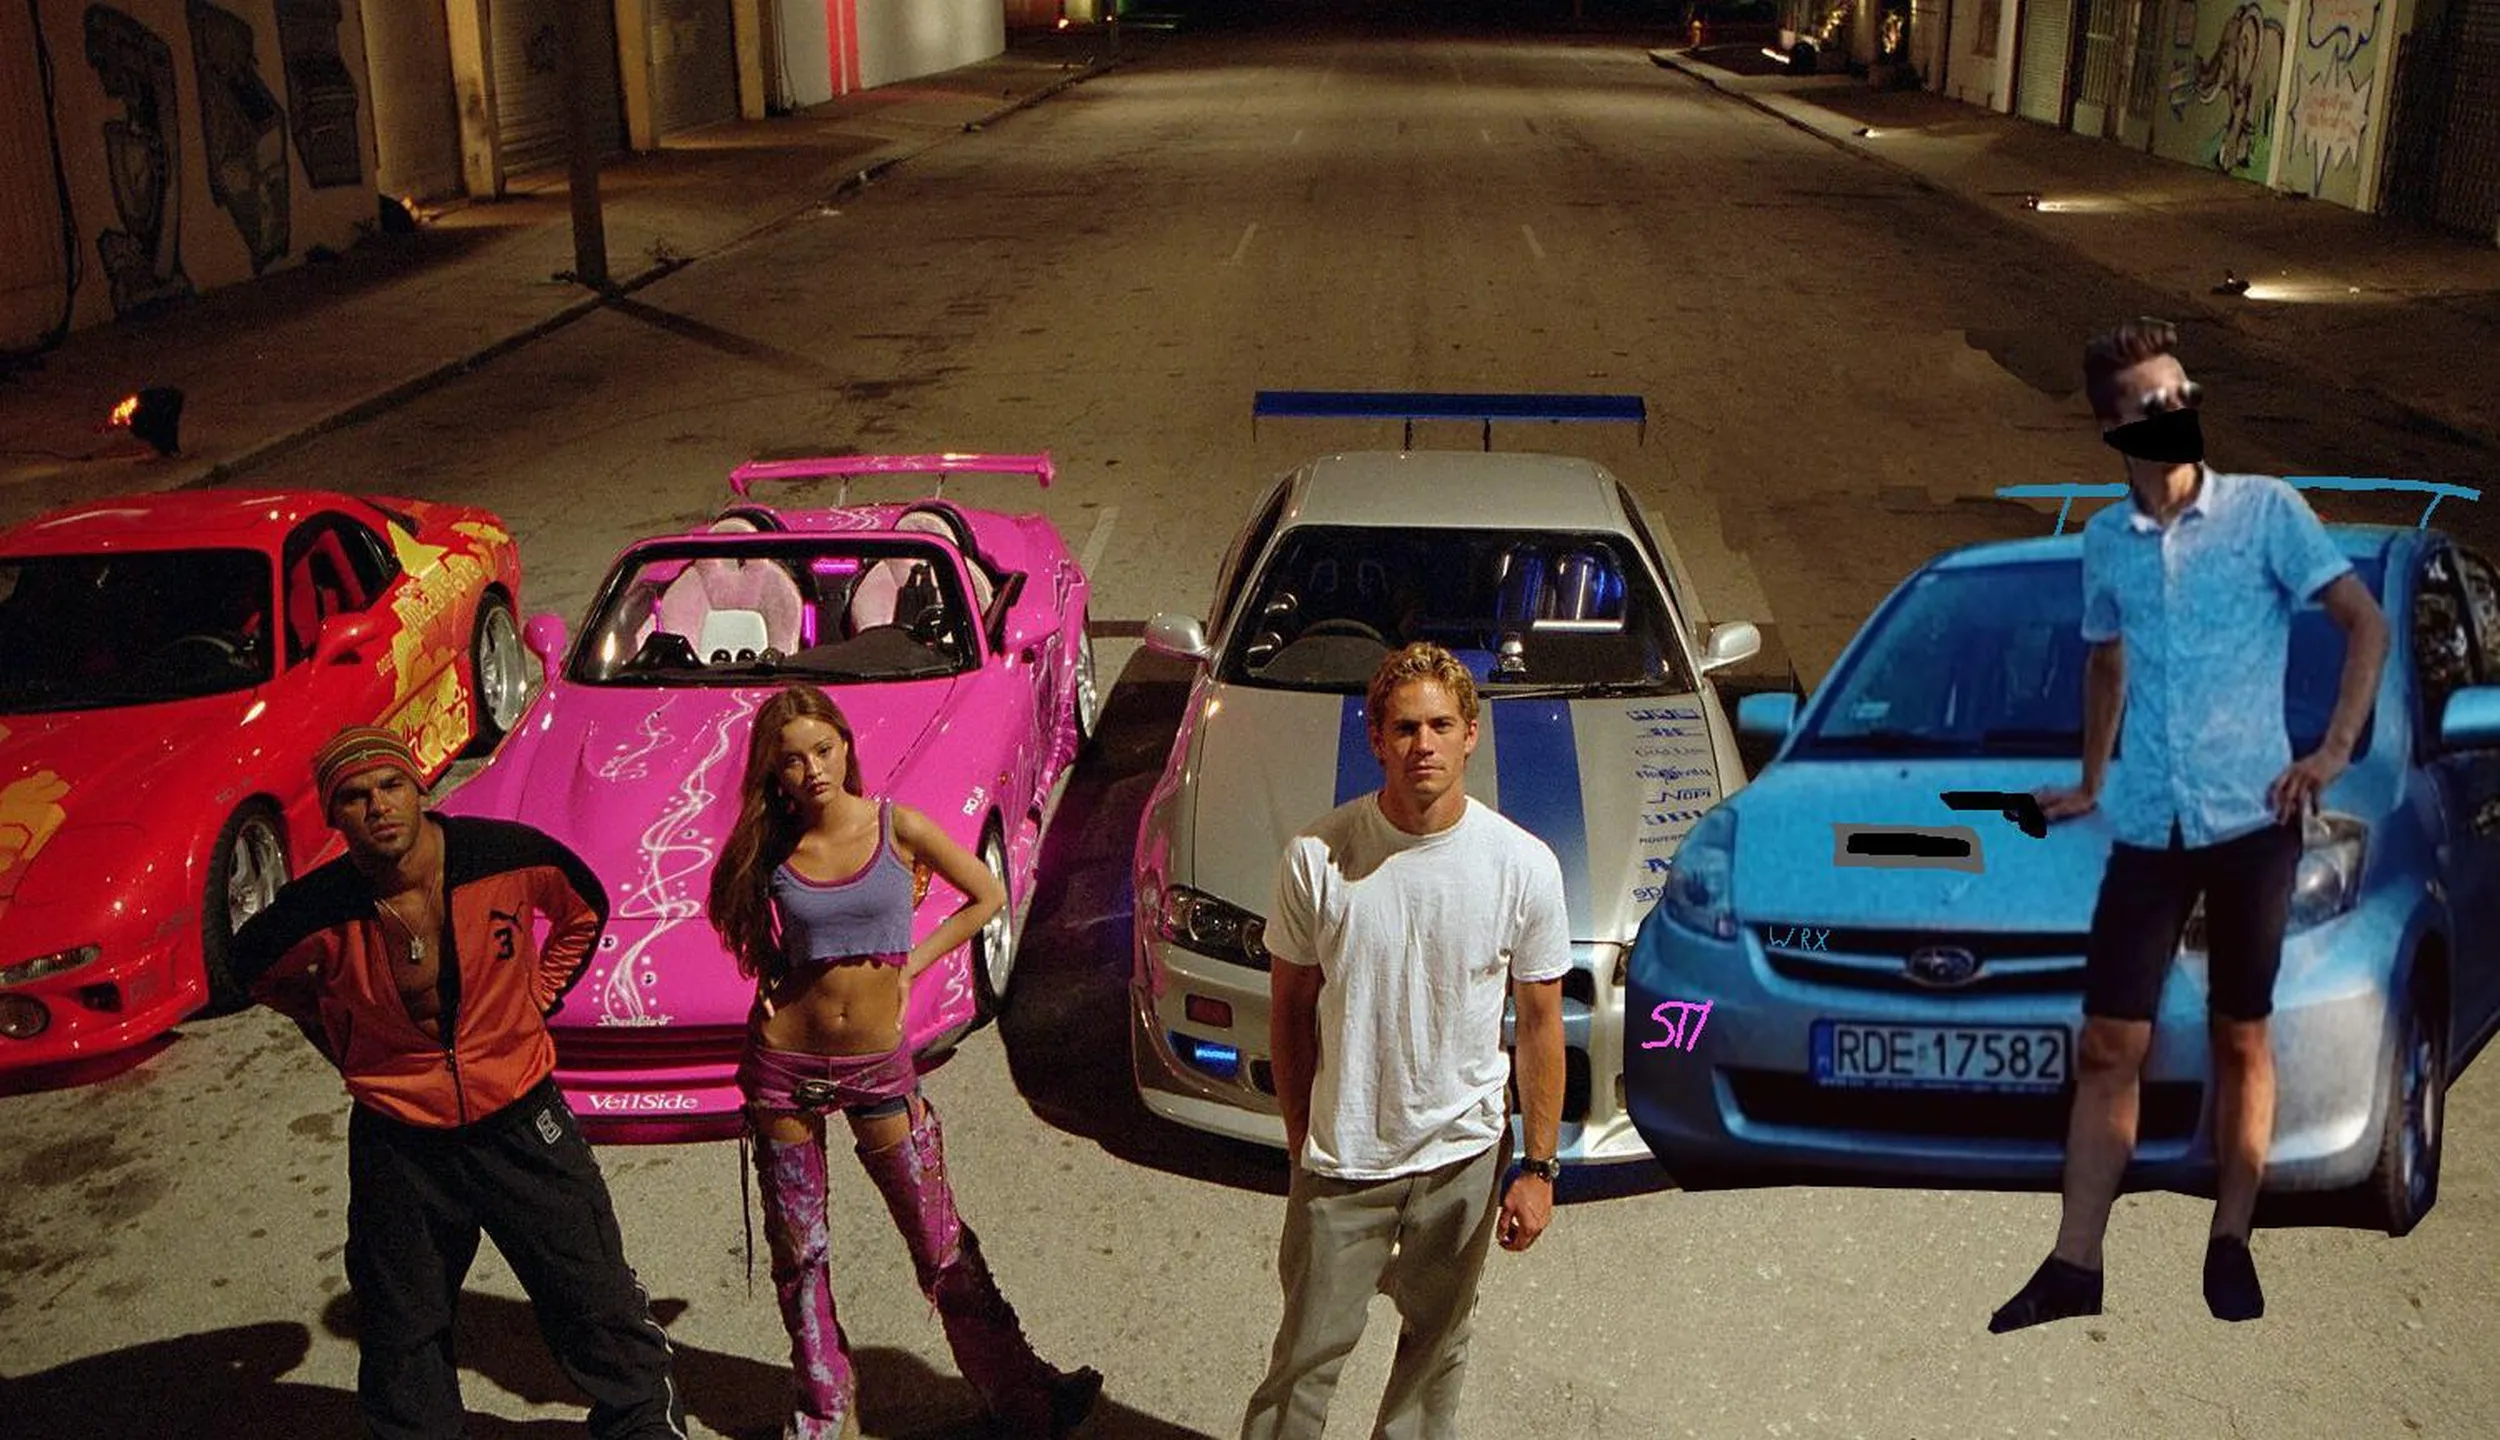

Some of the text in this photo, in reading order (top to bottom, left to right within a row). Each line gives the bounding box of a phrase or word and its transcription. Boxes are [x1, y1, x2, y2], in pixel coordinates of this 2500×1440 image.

[492, 926, 515, 961] 3
[1837, 1029, 2061, 1079] RDE 17582
[588, 1092, 699, 1110] VeilSide
